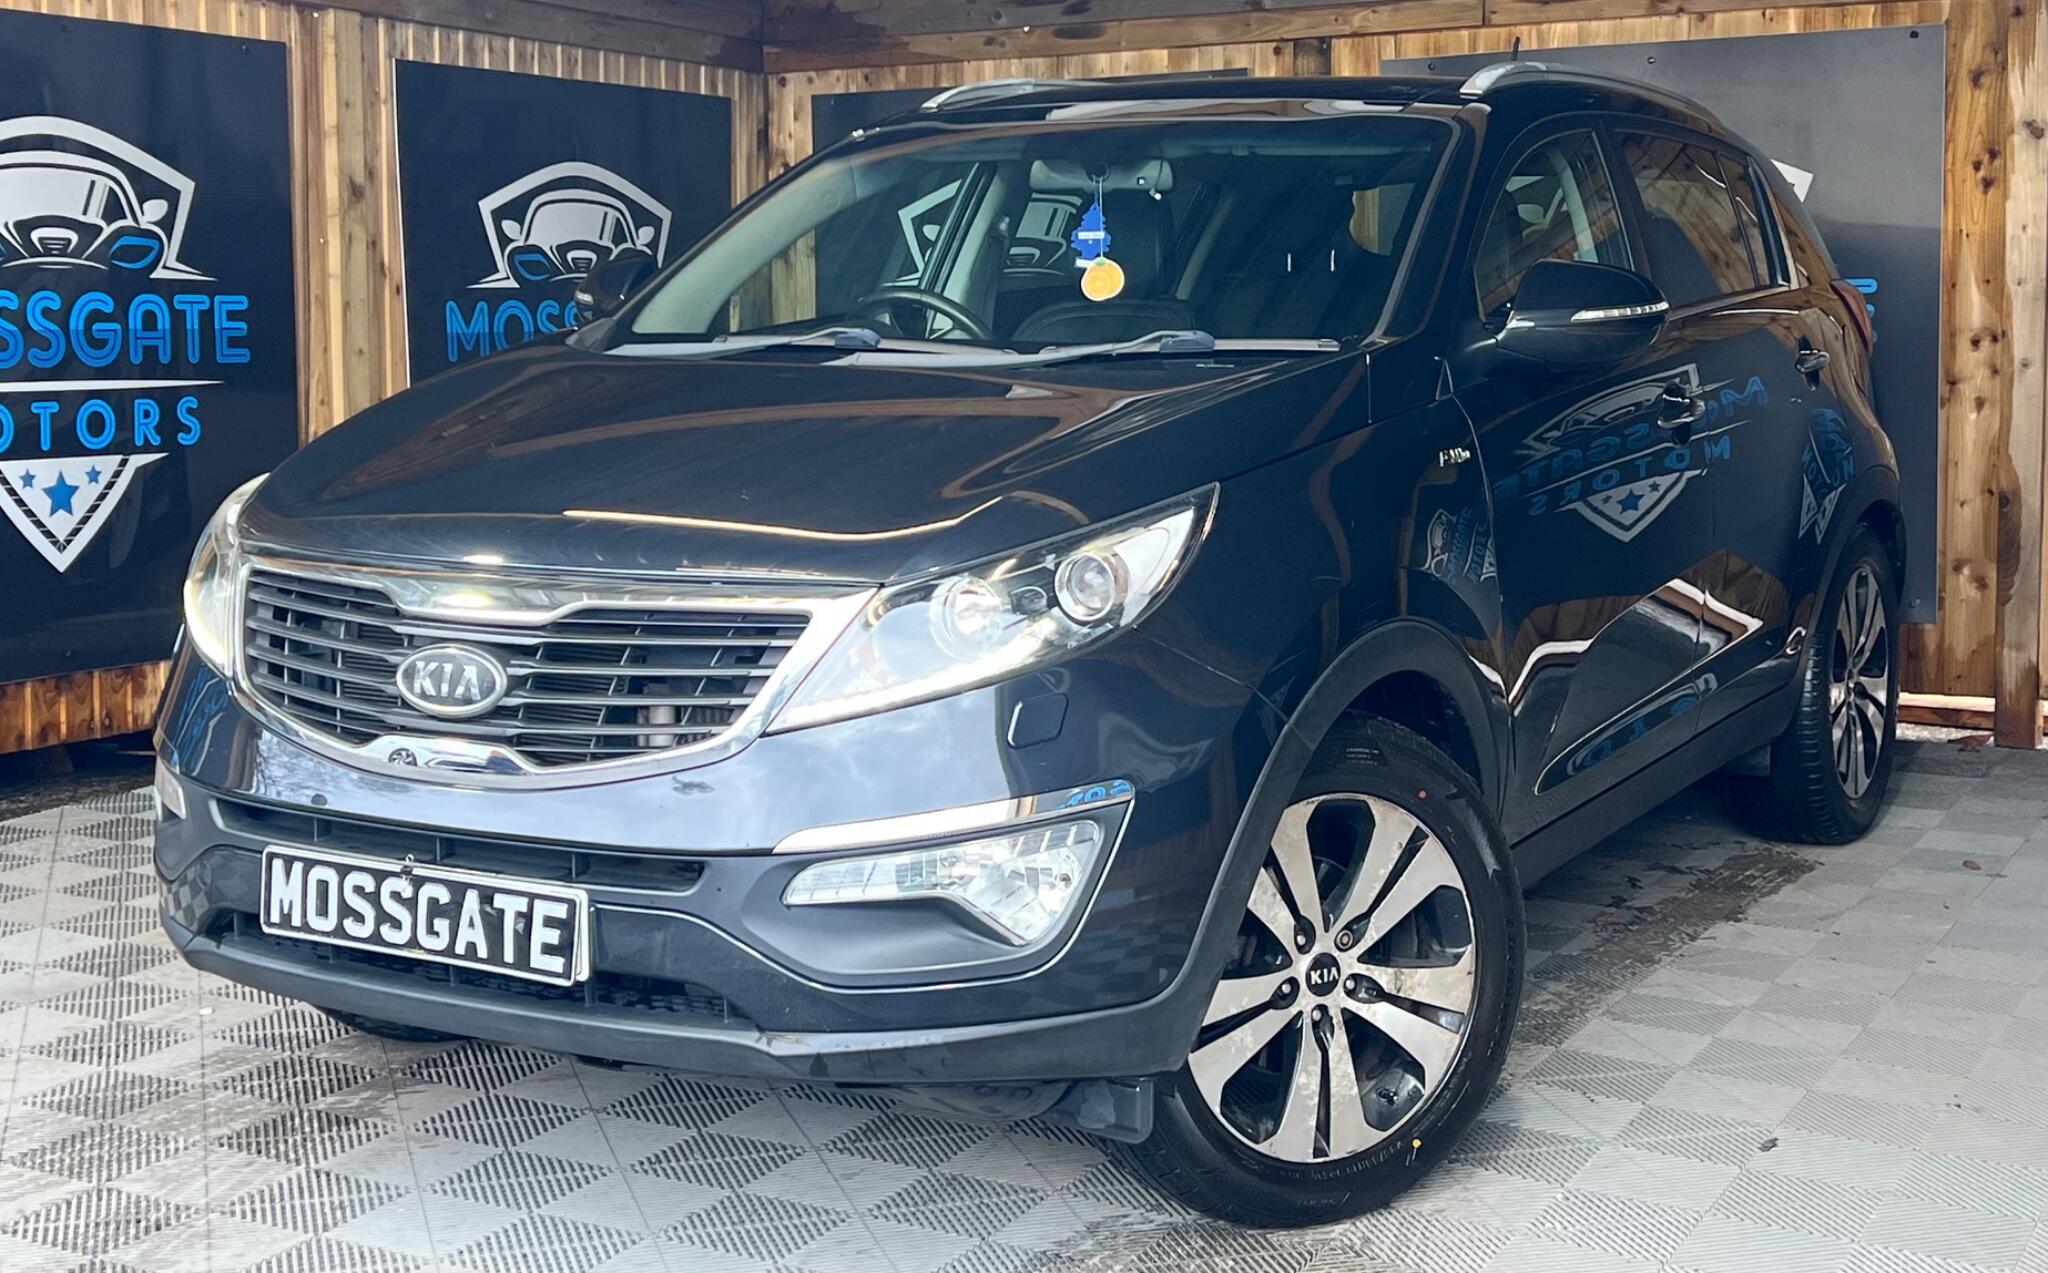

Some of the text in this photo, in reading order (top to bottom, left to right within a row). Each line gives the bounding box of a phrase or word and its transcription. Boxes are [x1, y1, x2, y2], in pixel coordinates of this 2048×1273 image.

[413, 660, 482, 701] KIA
[269, 857, 569, 974] MOSSGATE
[1310, 966, 1339, 985] KIA
